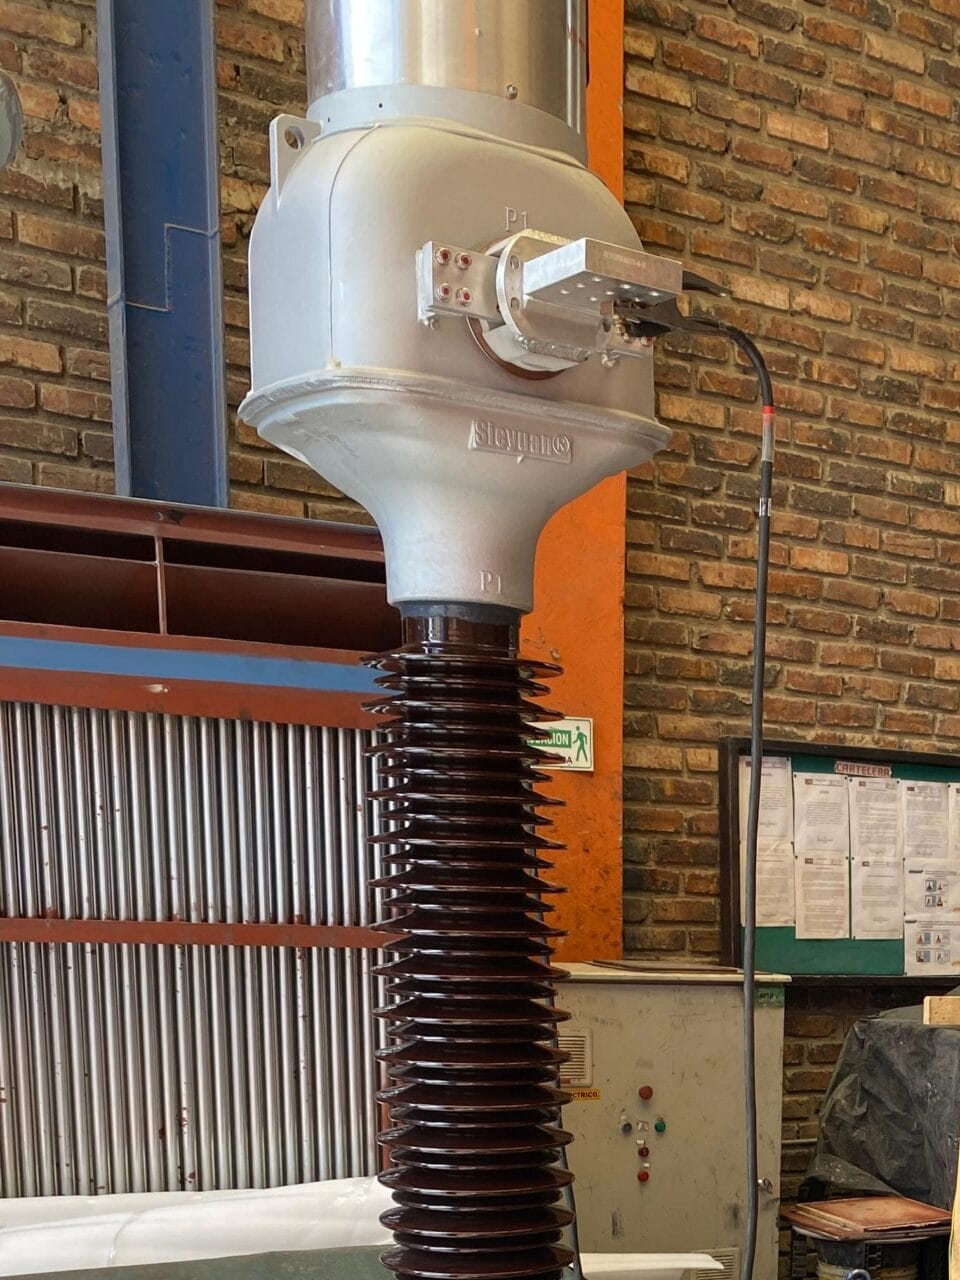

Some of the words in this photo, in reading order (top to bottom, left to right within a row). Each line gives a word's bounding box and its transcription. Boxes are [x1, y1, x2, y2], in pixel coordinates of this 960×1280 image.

[505, 206, 527, 230] P1
[480, 570, 502, 594] P1
[836, 762, 890, 777] CARTELERA
